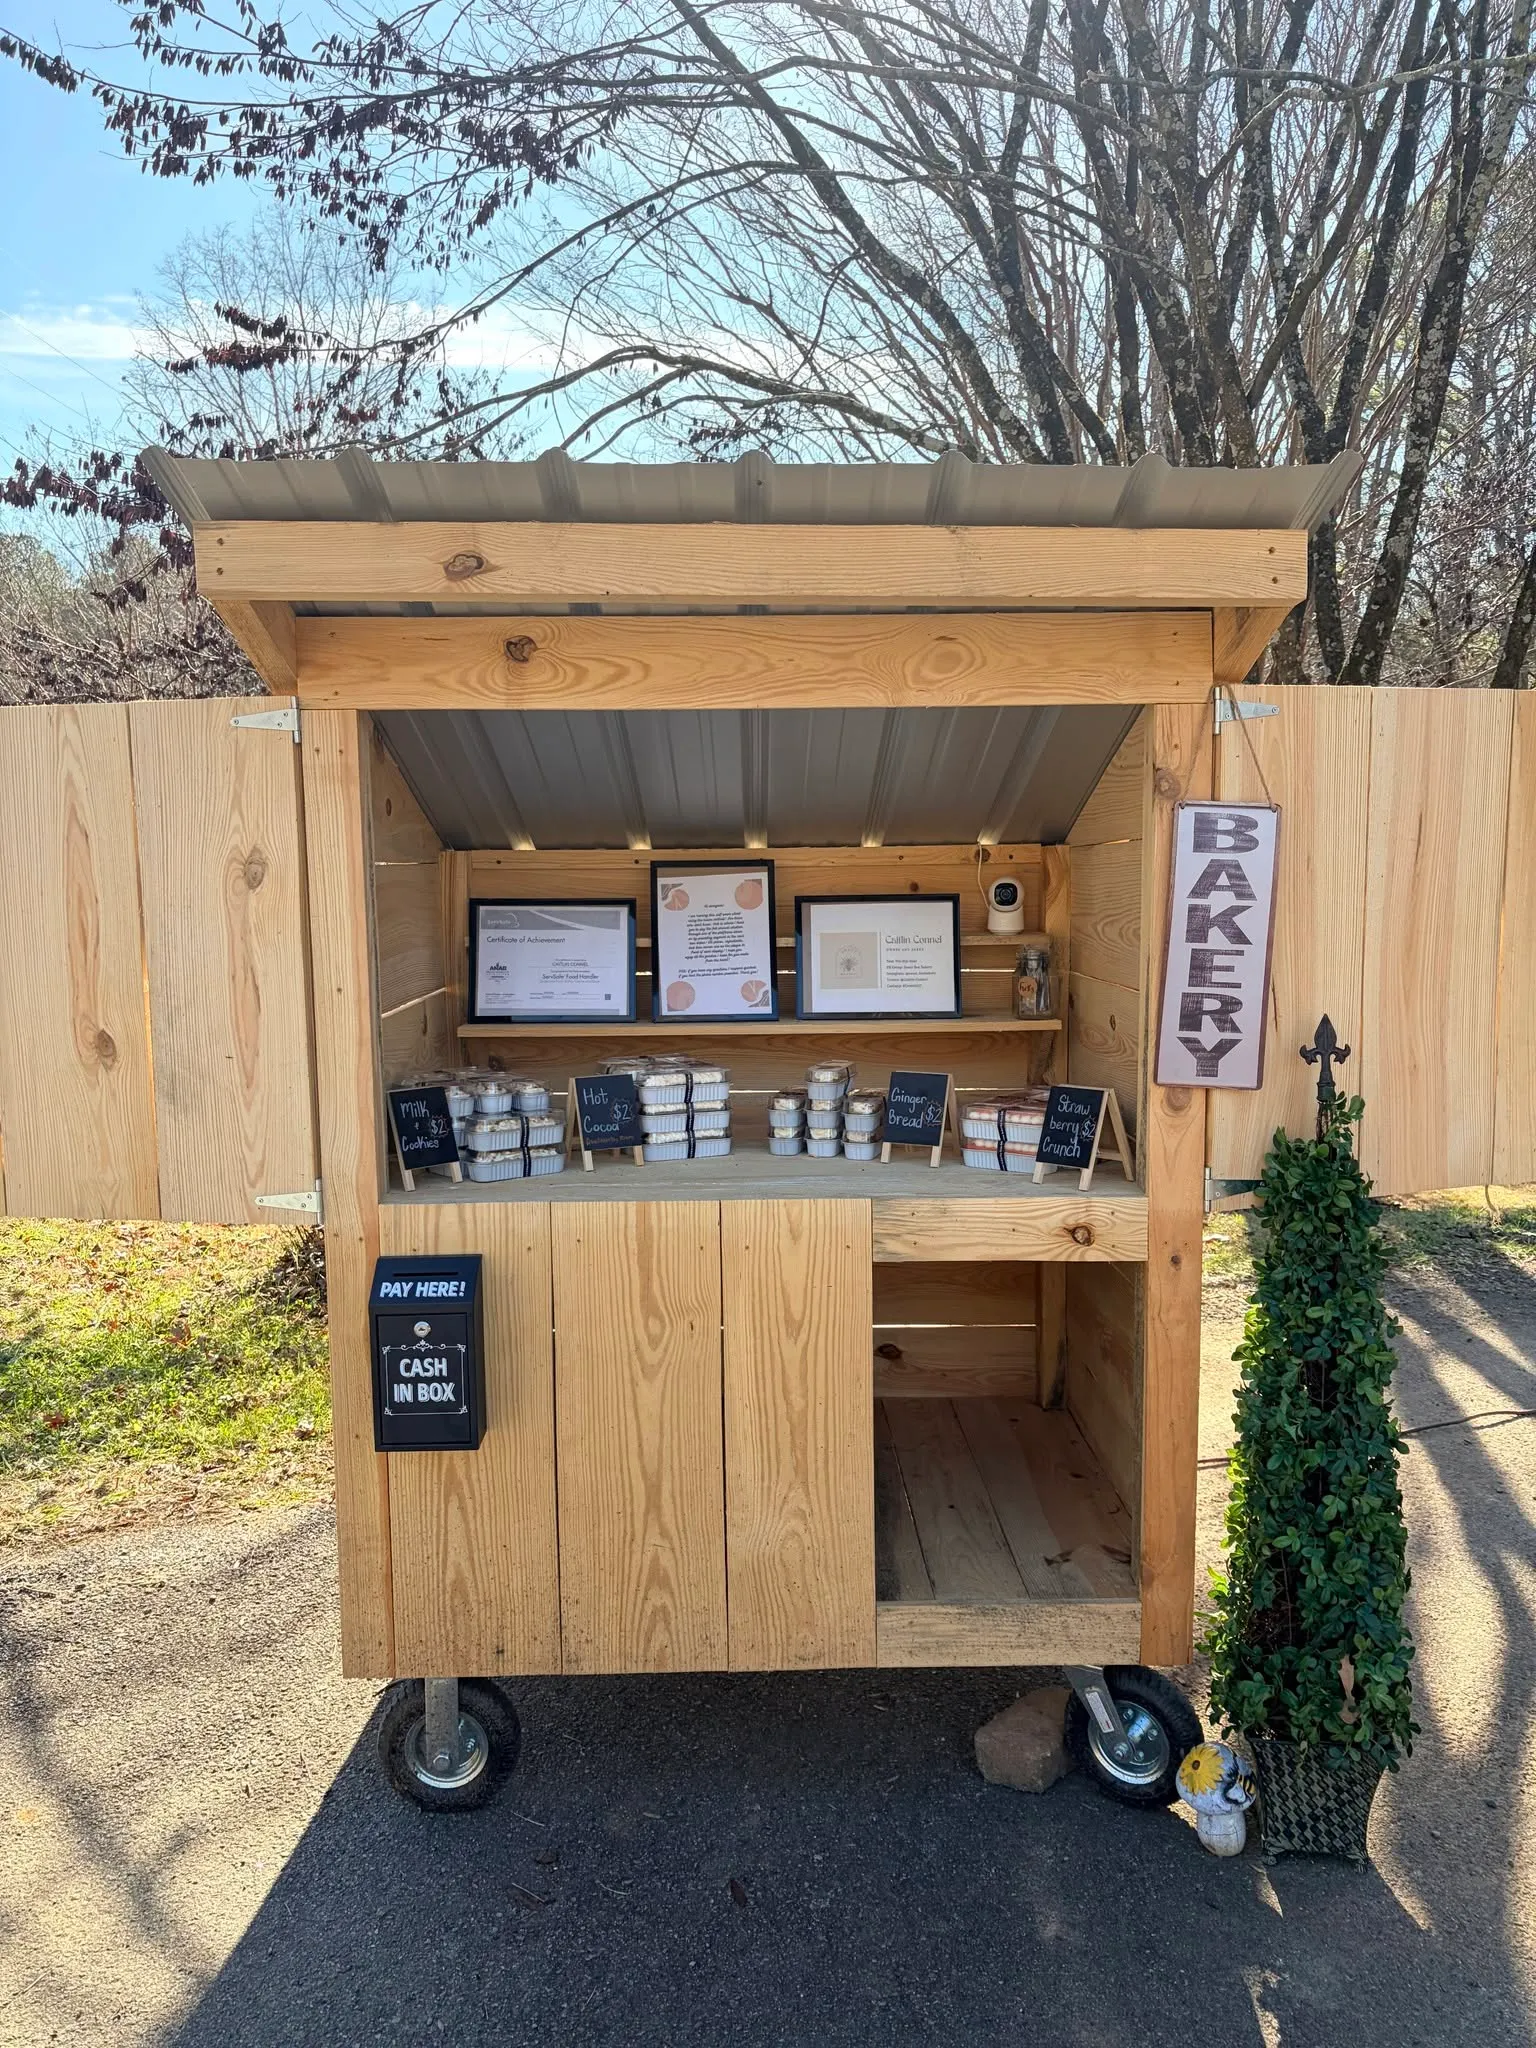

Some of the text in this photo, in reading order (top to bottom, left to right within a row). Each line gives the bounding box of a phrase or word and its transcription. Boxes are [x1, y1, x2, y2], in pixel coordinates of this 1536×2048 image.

[1176, 811, 1260, 1078] BAKERY
[583, 1087, 609, 1105] Hot
[891, 1087, 927, 1114] Ginger
[1057, 1094, 1091, 1116] Straw
[613, 1102, 632, 1120] $2
[888, 1108, 924, 1129] Bread
[926, 1104, 943, 1123] $2
[430, 1119, 447, 1135] $2
[583, 1115, 620, 1133] Cocoa
[1049, 1115, 1080, 1144] berry
[1082, 1120, 1096, 1138] $2
[402, 1135, 440, 1151] Cookies
[1042, 1135, 1081, 1158] Crunch
[379, 1281, 466, 1298] PAY HERE!
[399, 1357, 448, 1378] CASH
[393, 1382, 456, 1403] IN BOX
